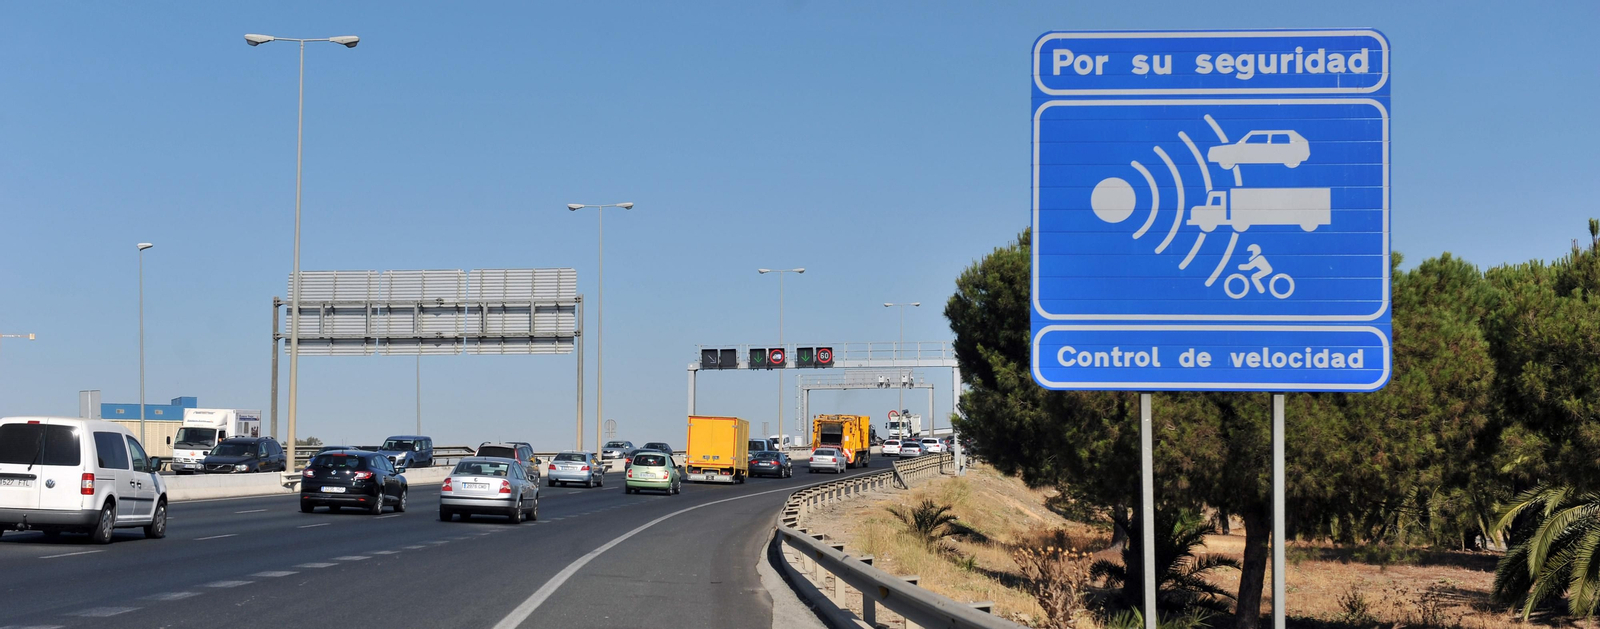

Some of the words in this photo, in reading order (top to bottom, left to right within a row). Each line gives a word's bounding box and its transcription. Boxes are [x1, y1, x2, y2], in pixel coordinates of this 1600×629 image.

[1053, 49, 1109, 75] Por
[1132, 54, 1172, 74] su
[1195, 46, 1369, 80] seguridad
[1057, 346, 1161, 368] Control
[1178, 348, 1212, 368] de
[1230, 347, 1364, 369] velocidad
